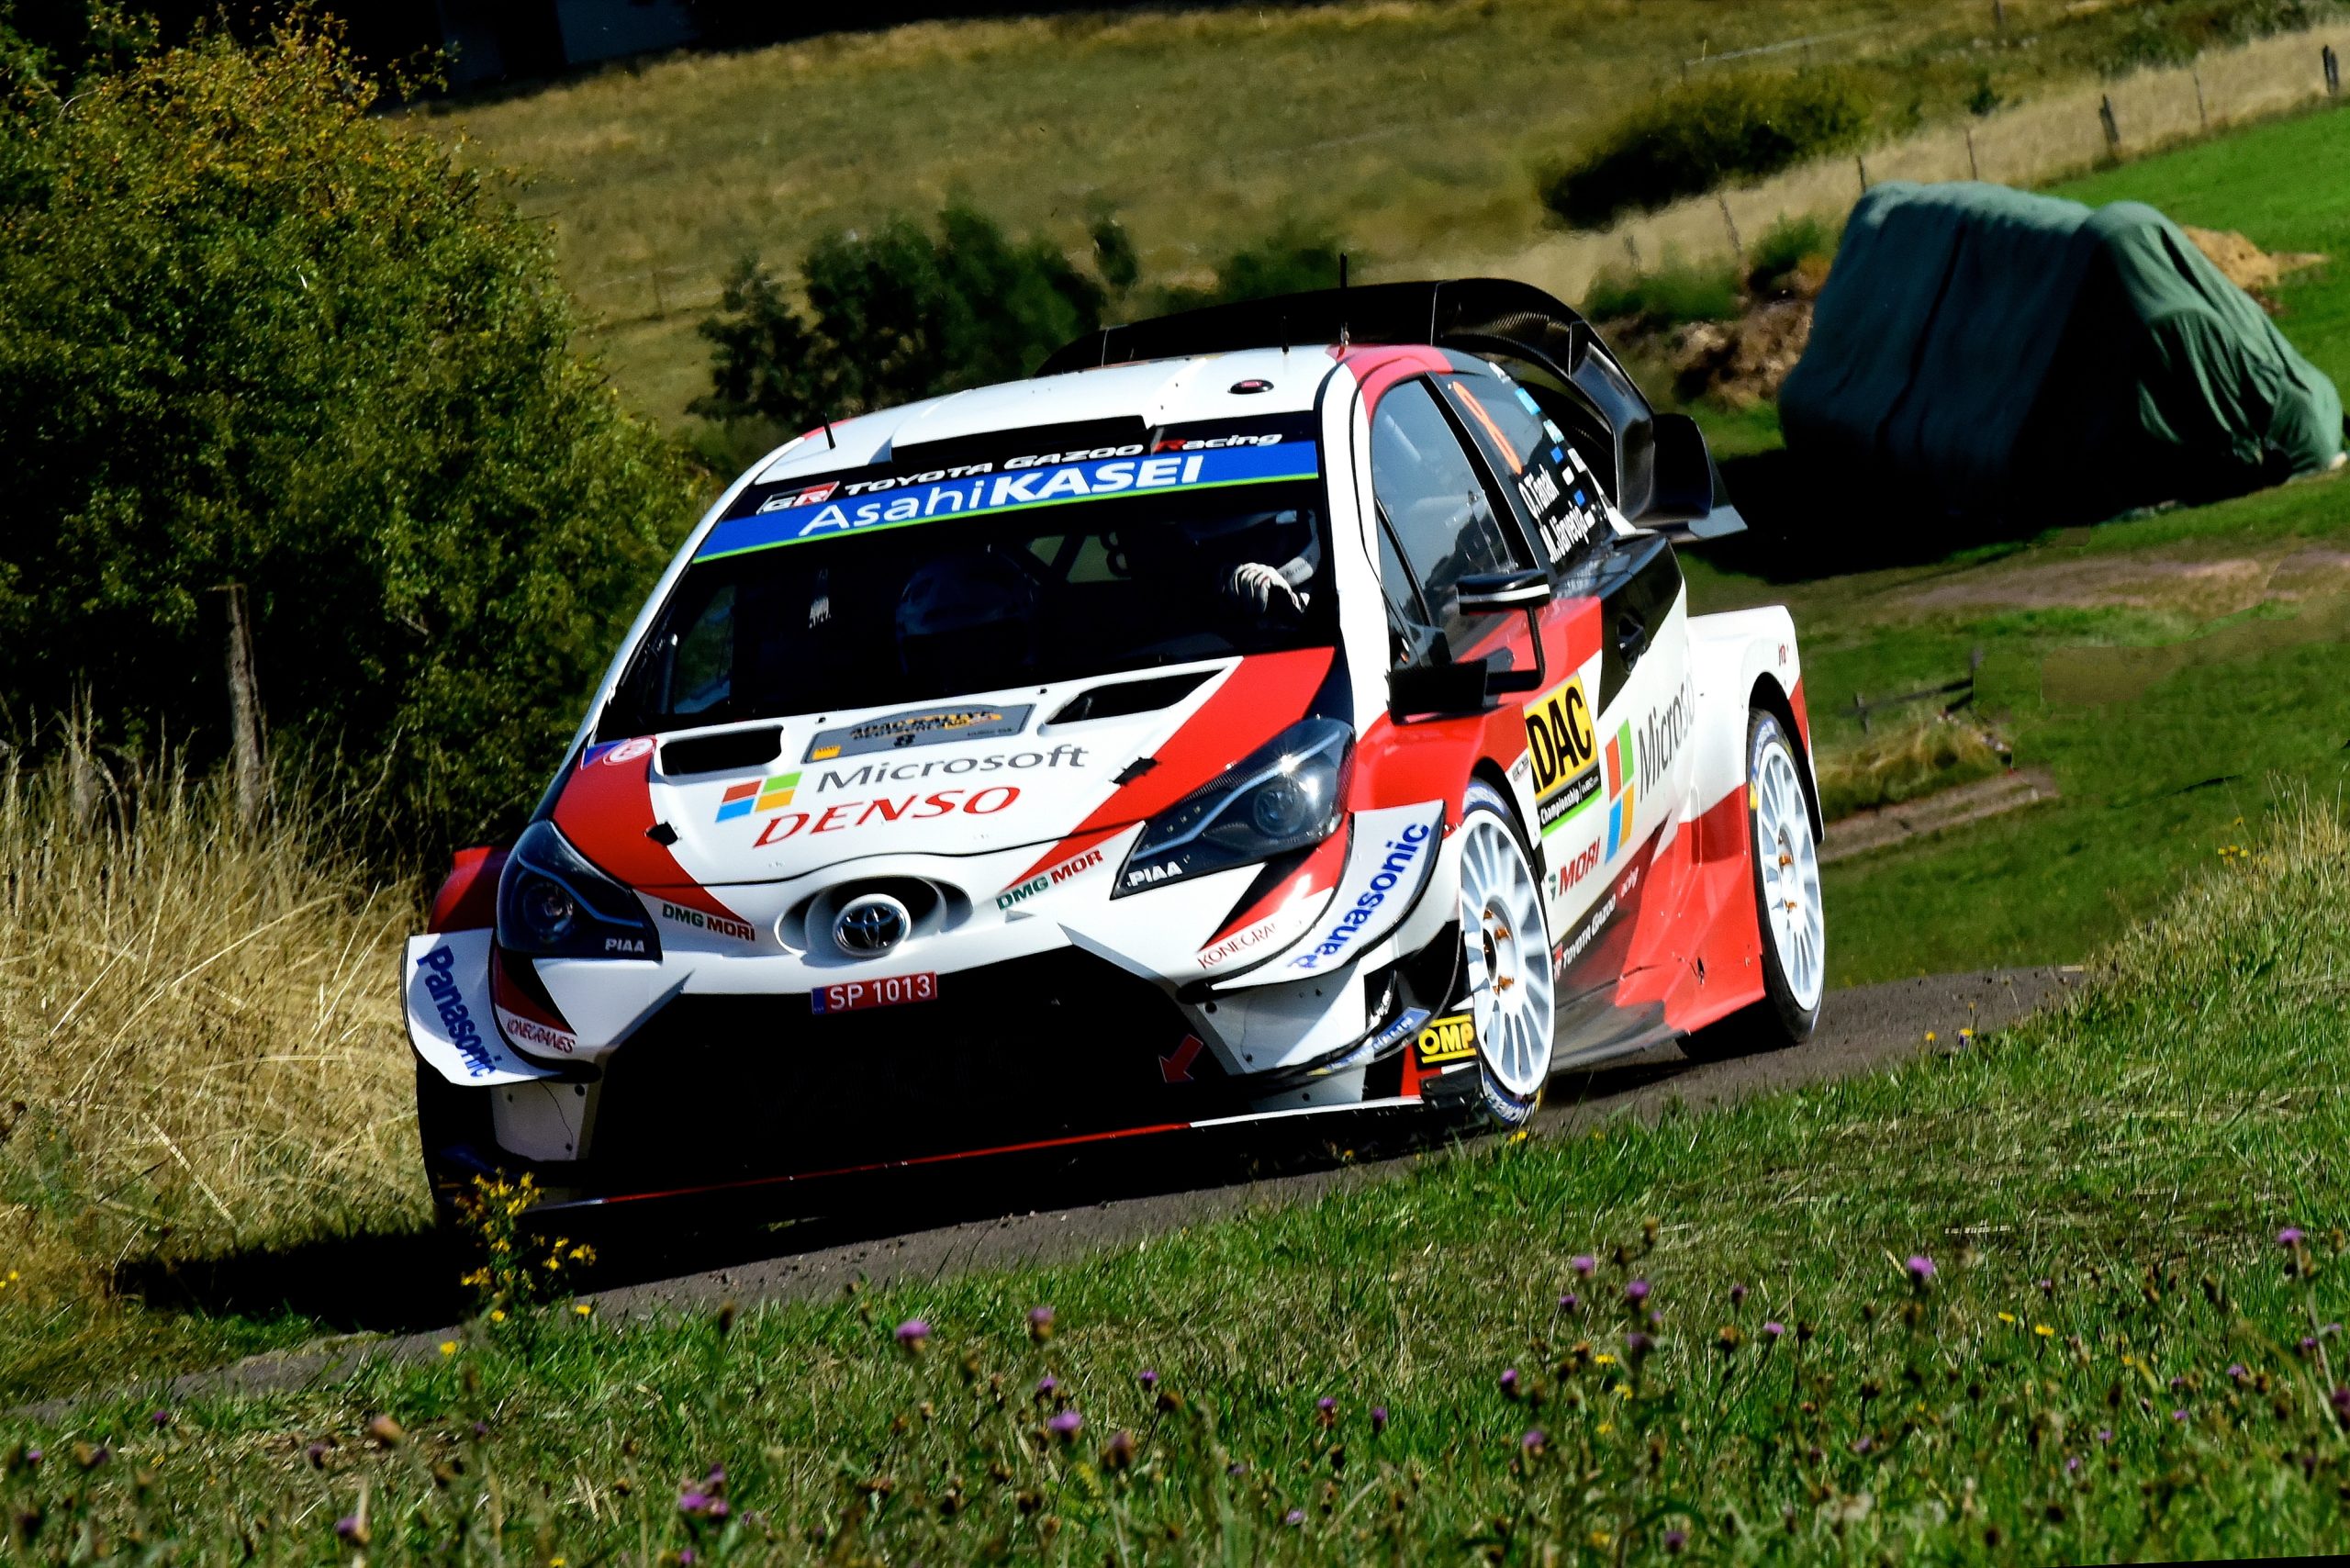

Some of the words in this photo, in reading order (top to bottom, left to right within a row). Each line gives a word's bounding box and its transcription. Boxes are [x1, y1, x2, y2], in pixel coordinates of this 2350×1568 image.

[845, 463, 993, 496] TOYOTA
[1004, 444, 1144, 470] GAZOO
[1153, 433, 1282, 452] Racing
[1526, 686, 1592, 795] DAC
[1638, 672, 1695, 803] Microso
[817, 744, 1090, 793] Microsoft
[753, 786, 1022, 848] DENSO
[1128, 861, 1183, 887] PIAA
[1559, 836, 1601, 896] MORI
[995, 876, 1049, 910] DMG
[1286, 823, 1430, 969] Panasonic
[604, 937, 645, 954] PIAA
[662, 902, 704, 928] DMG
[706, 915, 755, 942] MORI
[1562, 924, 1592, 969] TOYOTA
[416, 945, 503, 1078] Panasonic
[829, 982, 864, 1010] SP
[872, 974, 932, 1004] 1013
[1418, 1022, 1475, 1056] OMP
